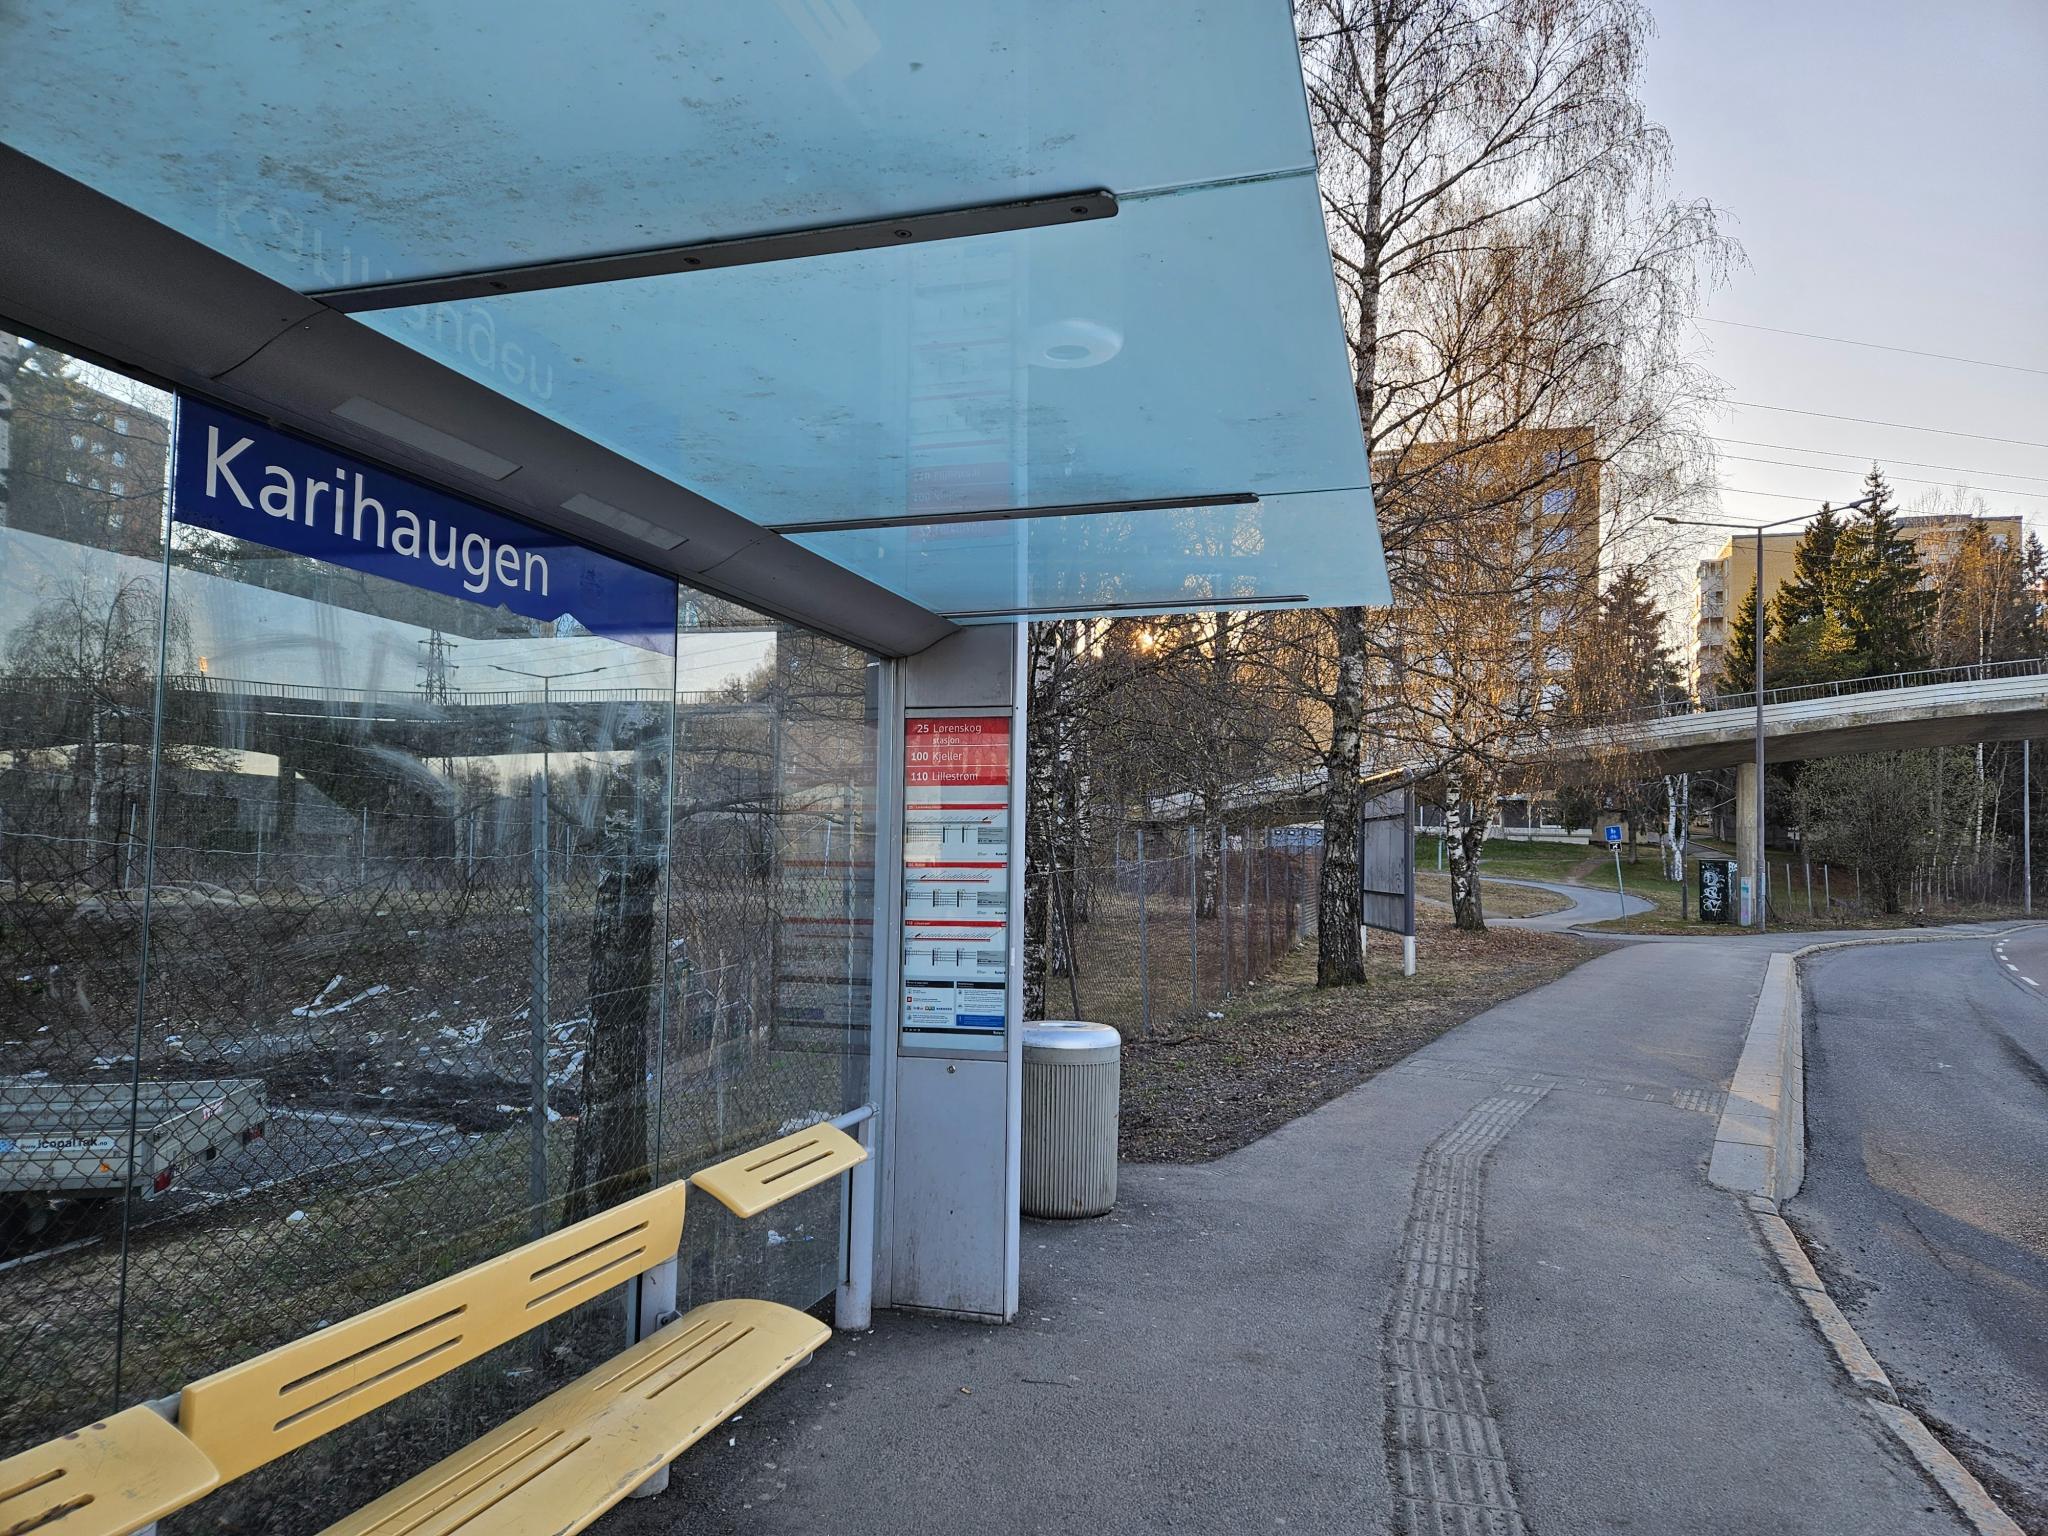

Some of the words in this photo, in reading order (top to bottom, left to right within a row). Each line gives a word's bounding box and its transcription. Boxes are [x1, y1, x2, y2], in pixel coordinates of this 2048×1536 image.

[205, 425, 550, 594] Karihaugen
[917, 724, 929, 733] 25
[933, 723, 982, 734] Lørenskog
[932, 736, 960, 746] stasjon
[911, 752, 929, 761] 100
[932, 751, 962, 763] Kjeller
[911, 772, 928, 781] 110
[932, 771, 978, 781] Lillestrøm
